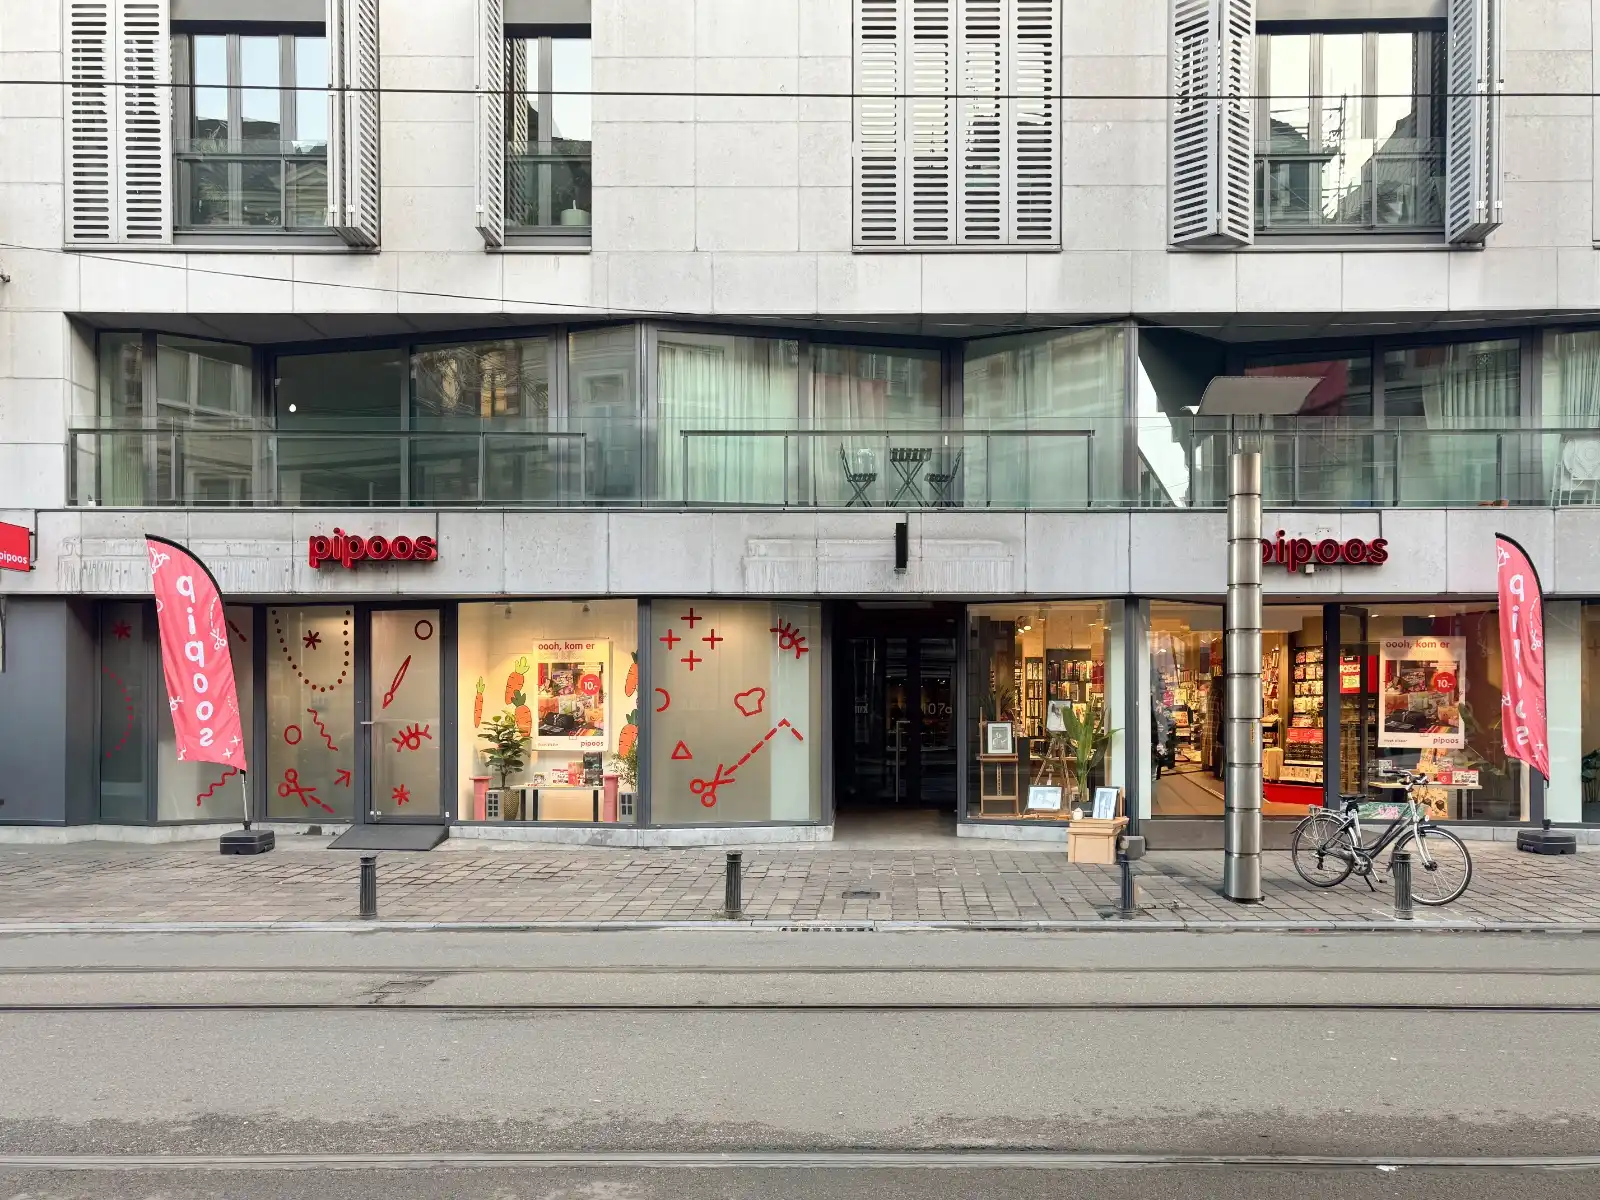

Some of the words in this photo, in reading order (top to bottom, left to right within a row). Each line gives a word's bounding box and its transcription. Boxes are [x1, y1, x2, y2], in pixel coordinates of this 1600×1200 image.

[308, 527, 437, 569] pipoos
[538, 642, 562, 651] oooh,
[564, 642, 583, 650] kom
[1386, 639, 1412, 650] oooh,
[1415, 639, 1437, 648] kom
[580, 740, 604, 748] pipoos
[1433, 736, 1459, 744] pipoos
